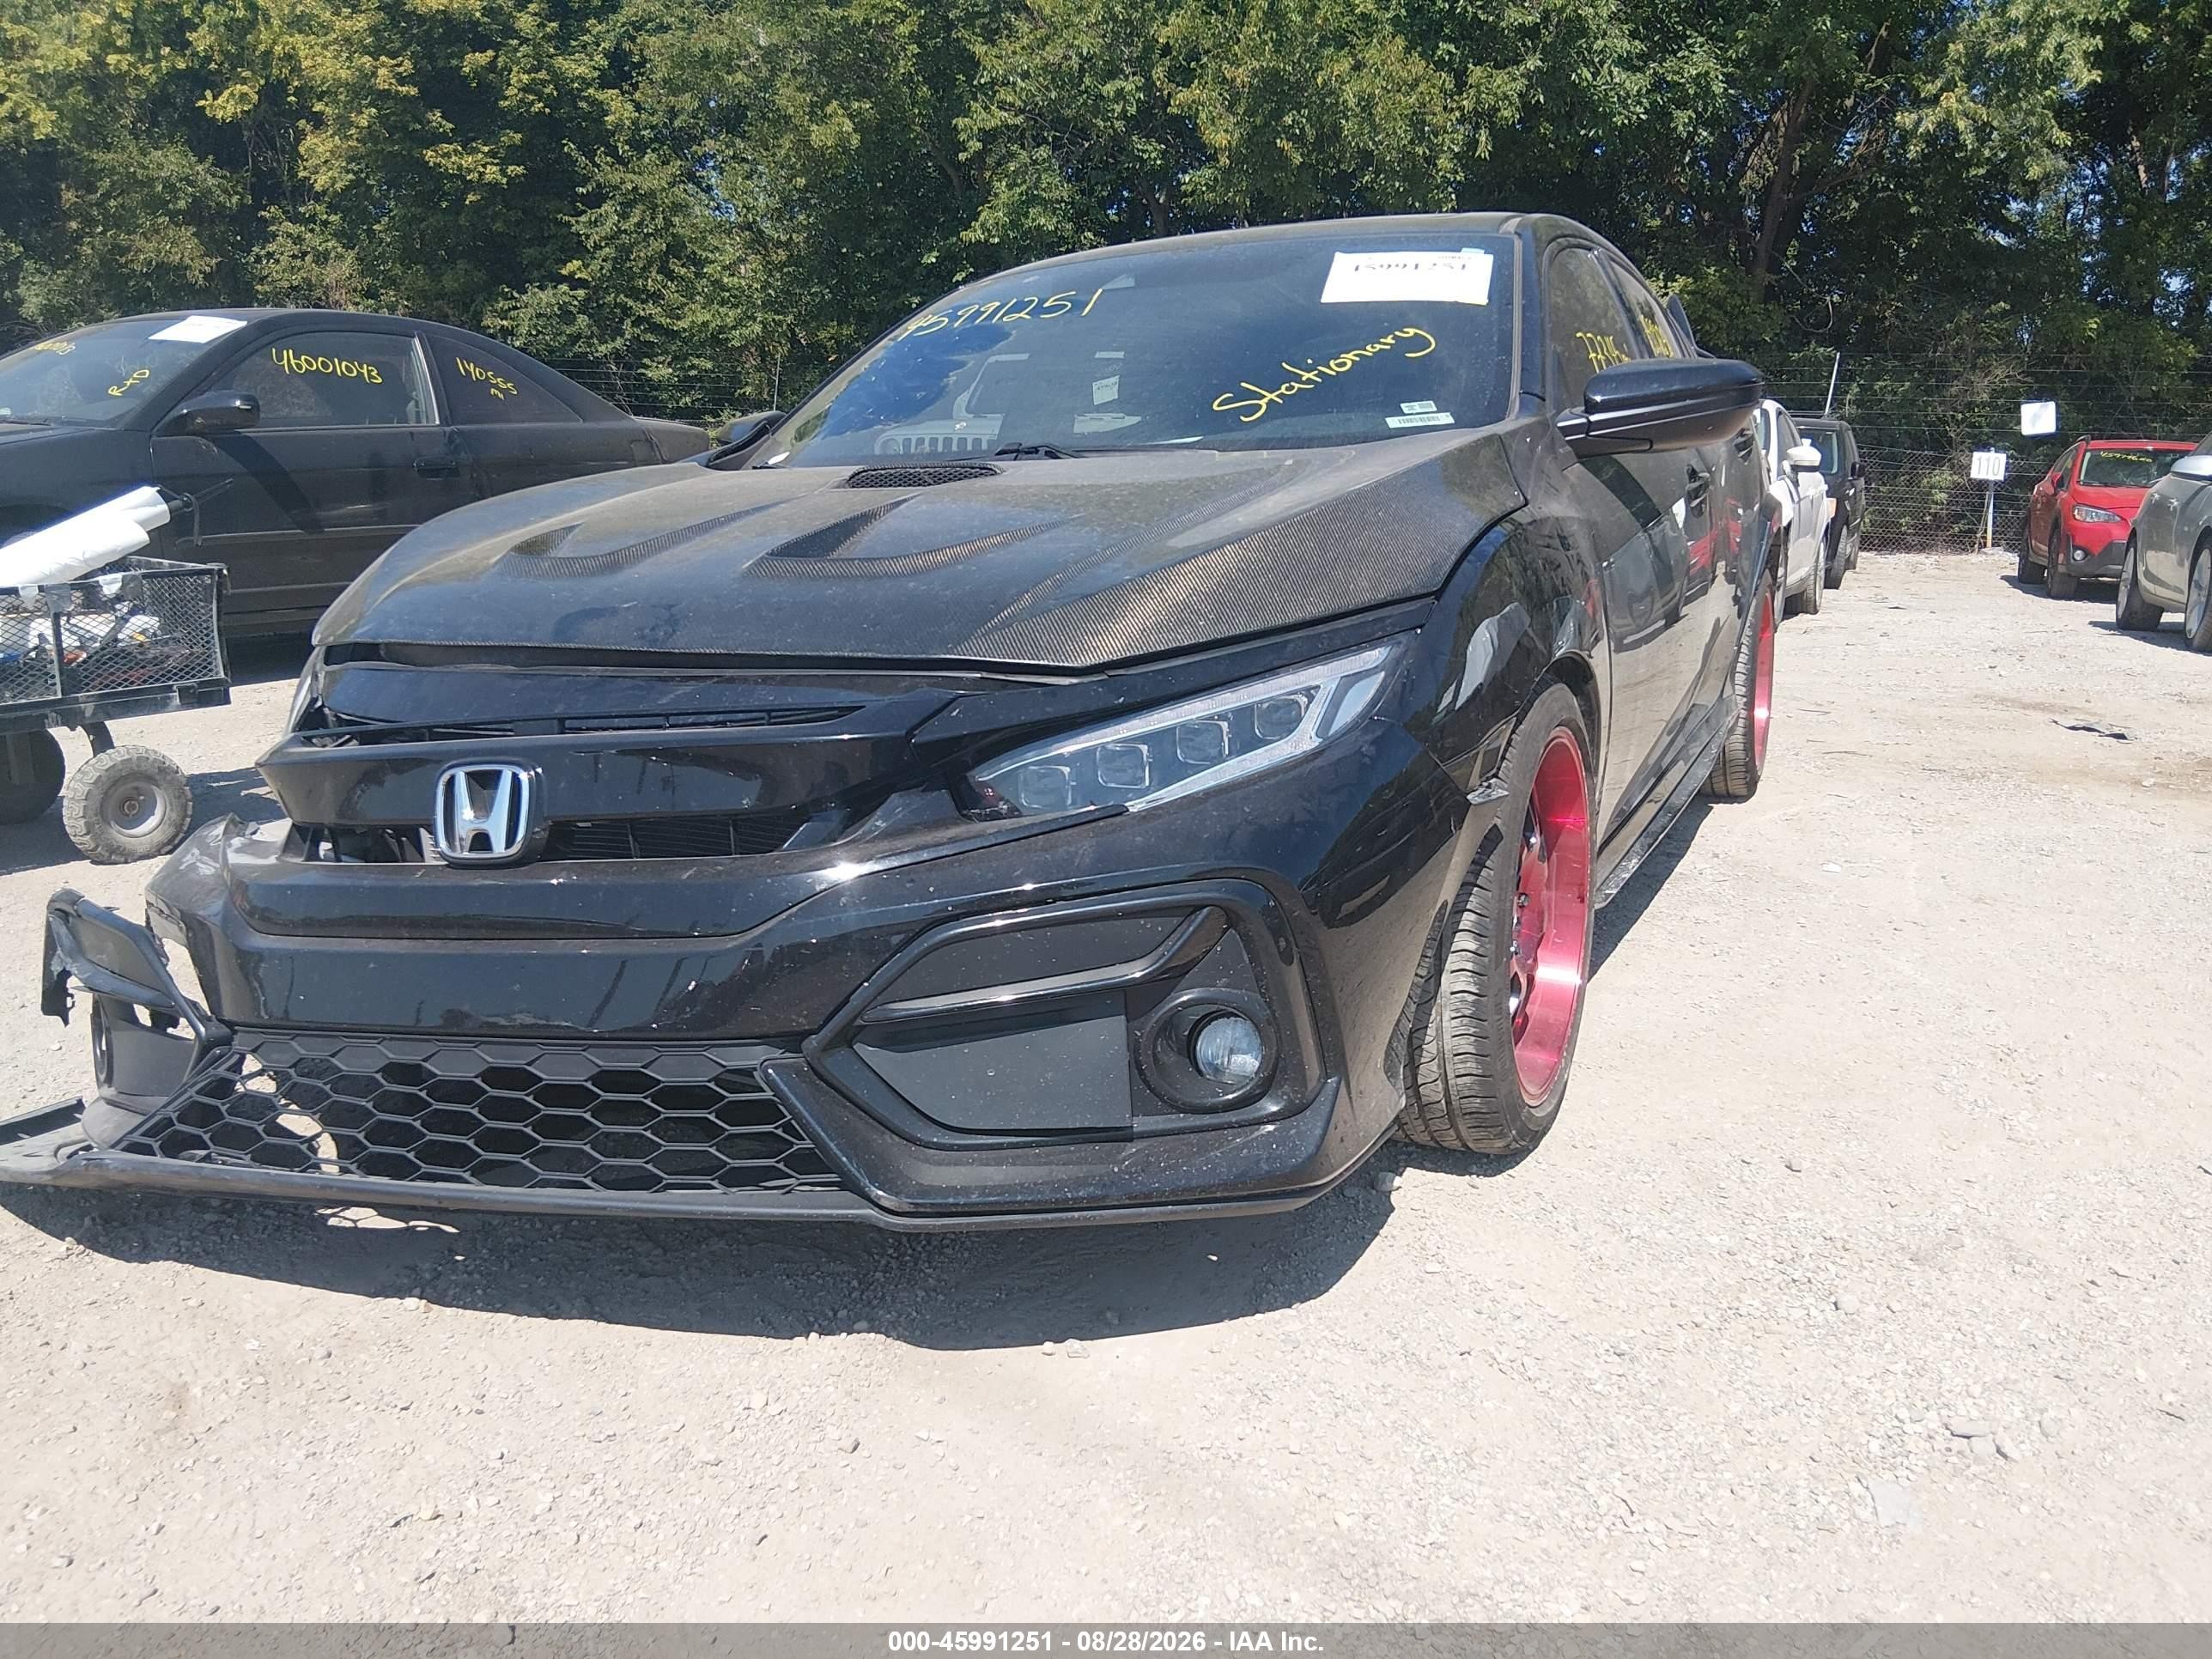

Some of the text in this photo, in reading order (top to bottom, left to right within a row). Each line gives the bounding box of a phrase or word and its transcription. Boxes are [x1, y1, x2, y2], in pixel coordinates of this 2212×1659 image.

[897, 288, 1103, 342] 45991251
[271, 347, 383, 384] 46001043
[455, 356, 518, 395] 140555
[1212, 327, 1436, 422] Stationary
[1977, 456, 2002, 477] 110
